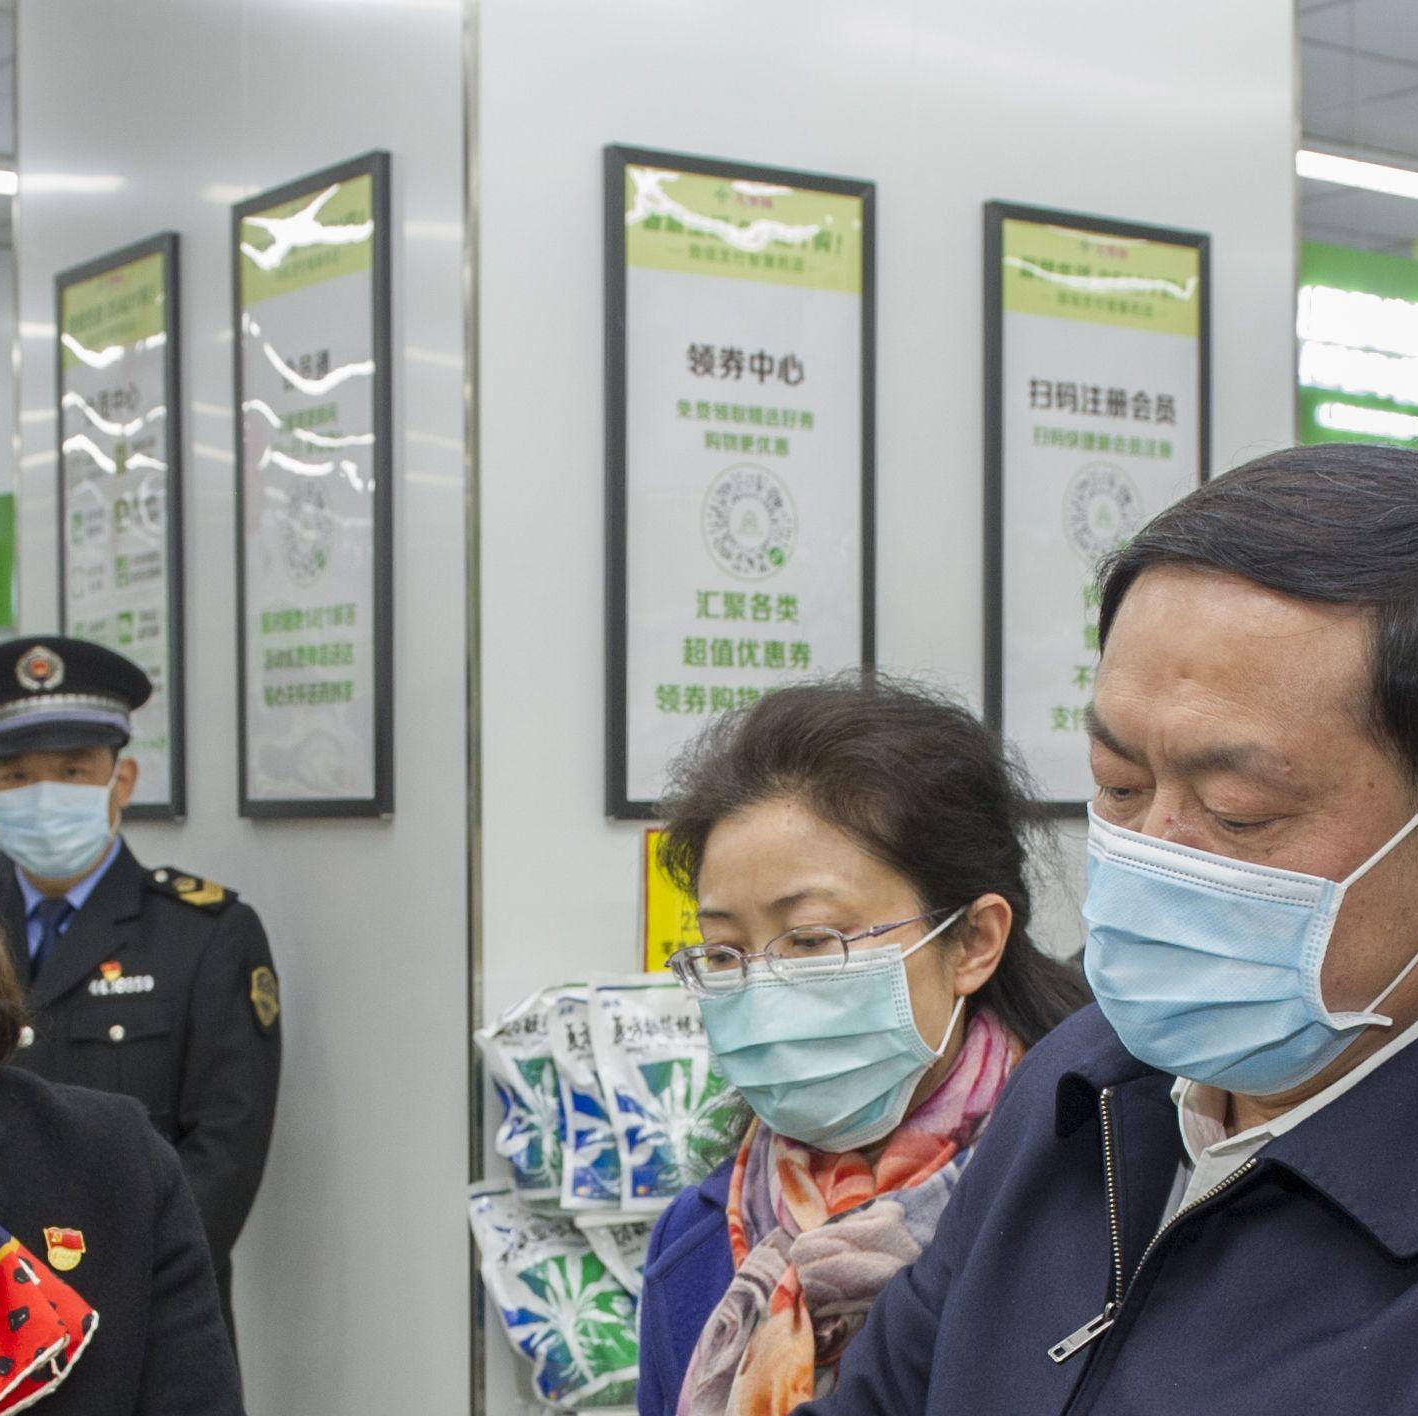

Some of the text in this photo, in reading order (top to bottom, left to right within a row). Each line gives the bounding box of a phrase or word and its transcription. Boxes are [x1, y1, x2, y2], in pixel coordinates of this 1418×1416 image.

[687, 341, 805, 387] 领券中心
[1028, 377, 1177, 428] 扫码注册会员
[695, 589, 799, 624] 汇聚各类
[683, 636, 812, 671] 超值优惠券
[654, 683, 779, 715] 领券购物
